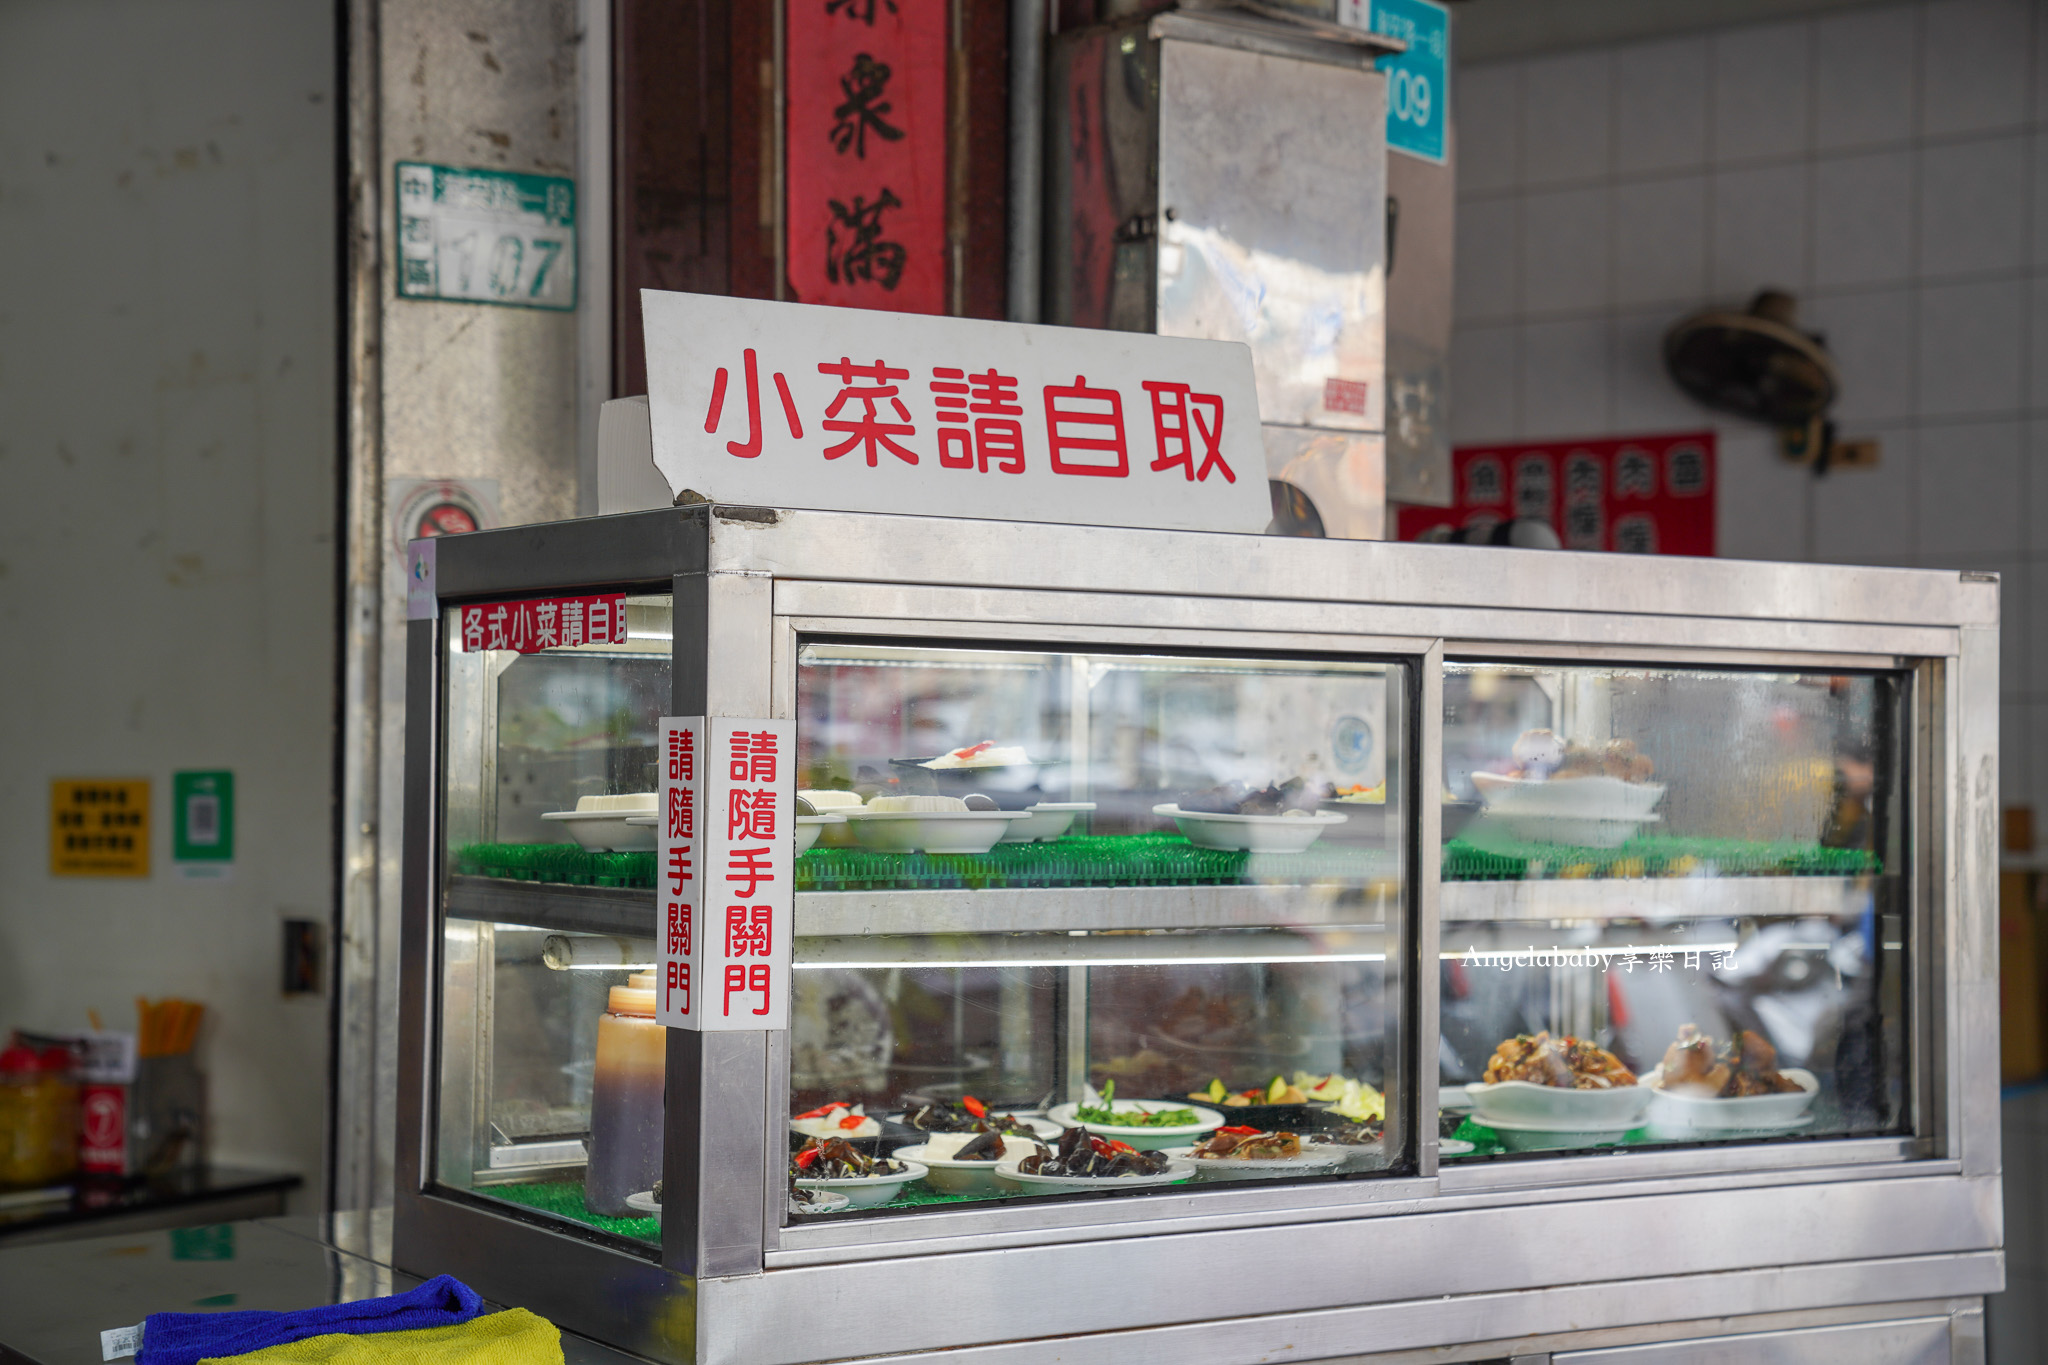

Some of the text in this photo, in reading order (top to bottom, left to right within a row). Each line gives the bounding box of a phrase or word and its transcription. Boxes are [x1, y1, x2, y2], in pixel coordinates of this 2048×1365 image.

[442, 231, 563, 297] 107
[704, 348, 1236, 485] 小菜請自取
[667, 728, 694, 1016] 請隨手關門
[723, 730, 778, 1017] 請隨手關門
